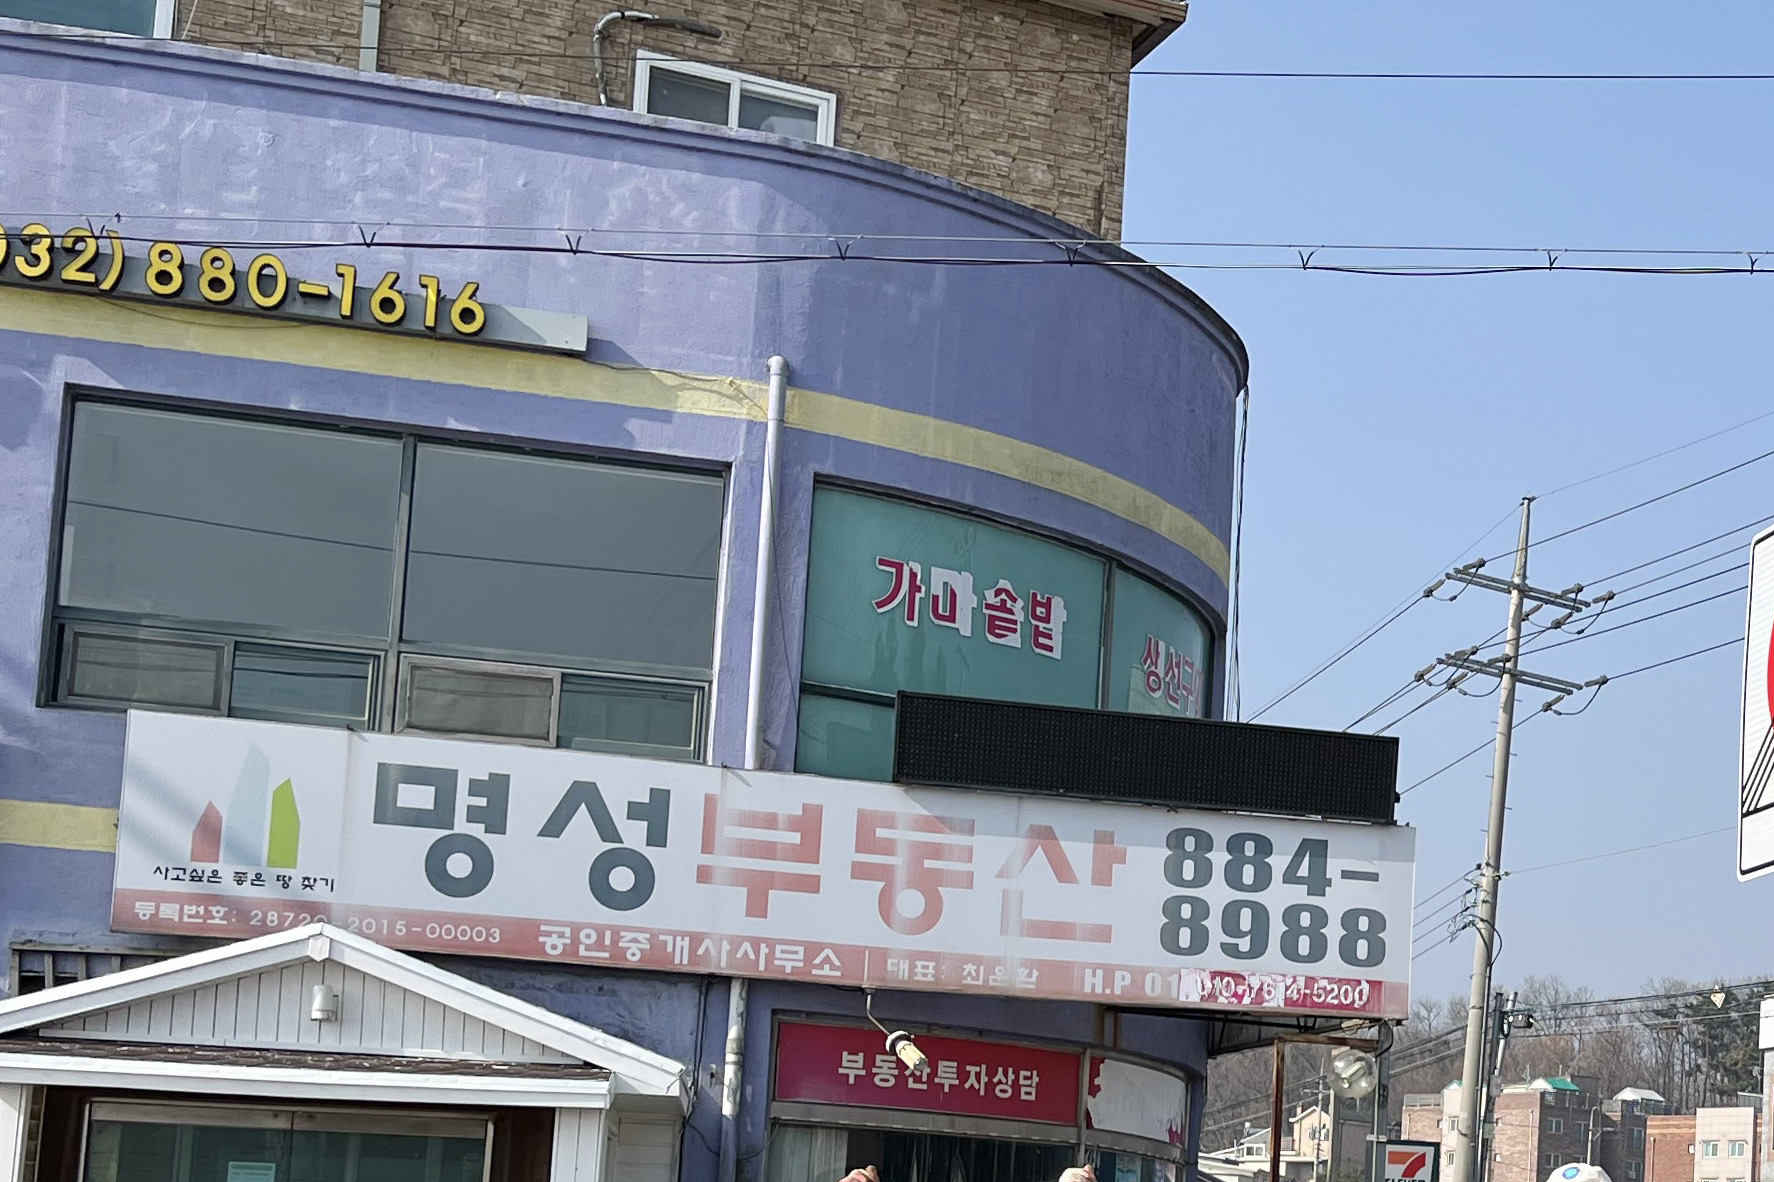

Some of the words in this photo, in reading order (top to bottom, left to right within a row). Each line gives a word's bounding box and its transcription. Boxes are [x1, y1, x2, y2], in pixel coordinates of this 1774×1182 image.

[0, 223, 124, 291] 32)
[153, 866, 223, 884] 사고싶은
[232, 871, 266, 888] 좋은
[276, 874, 291, 891] 땅
[301, 875, 335, 893] 찾기
[1164, 828, 1380, 897] 884-
[538, 923, 842, 978] 공인중개사사무소
[1084, 968, 1131, 995] H.P
[1160, 896, 1387, 968] 8988
[838, 1051, 1040, 1101] 부동산투자상담
